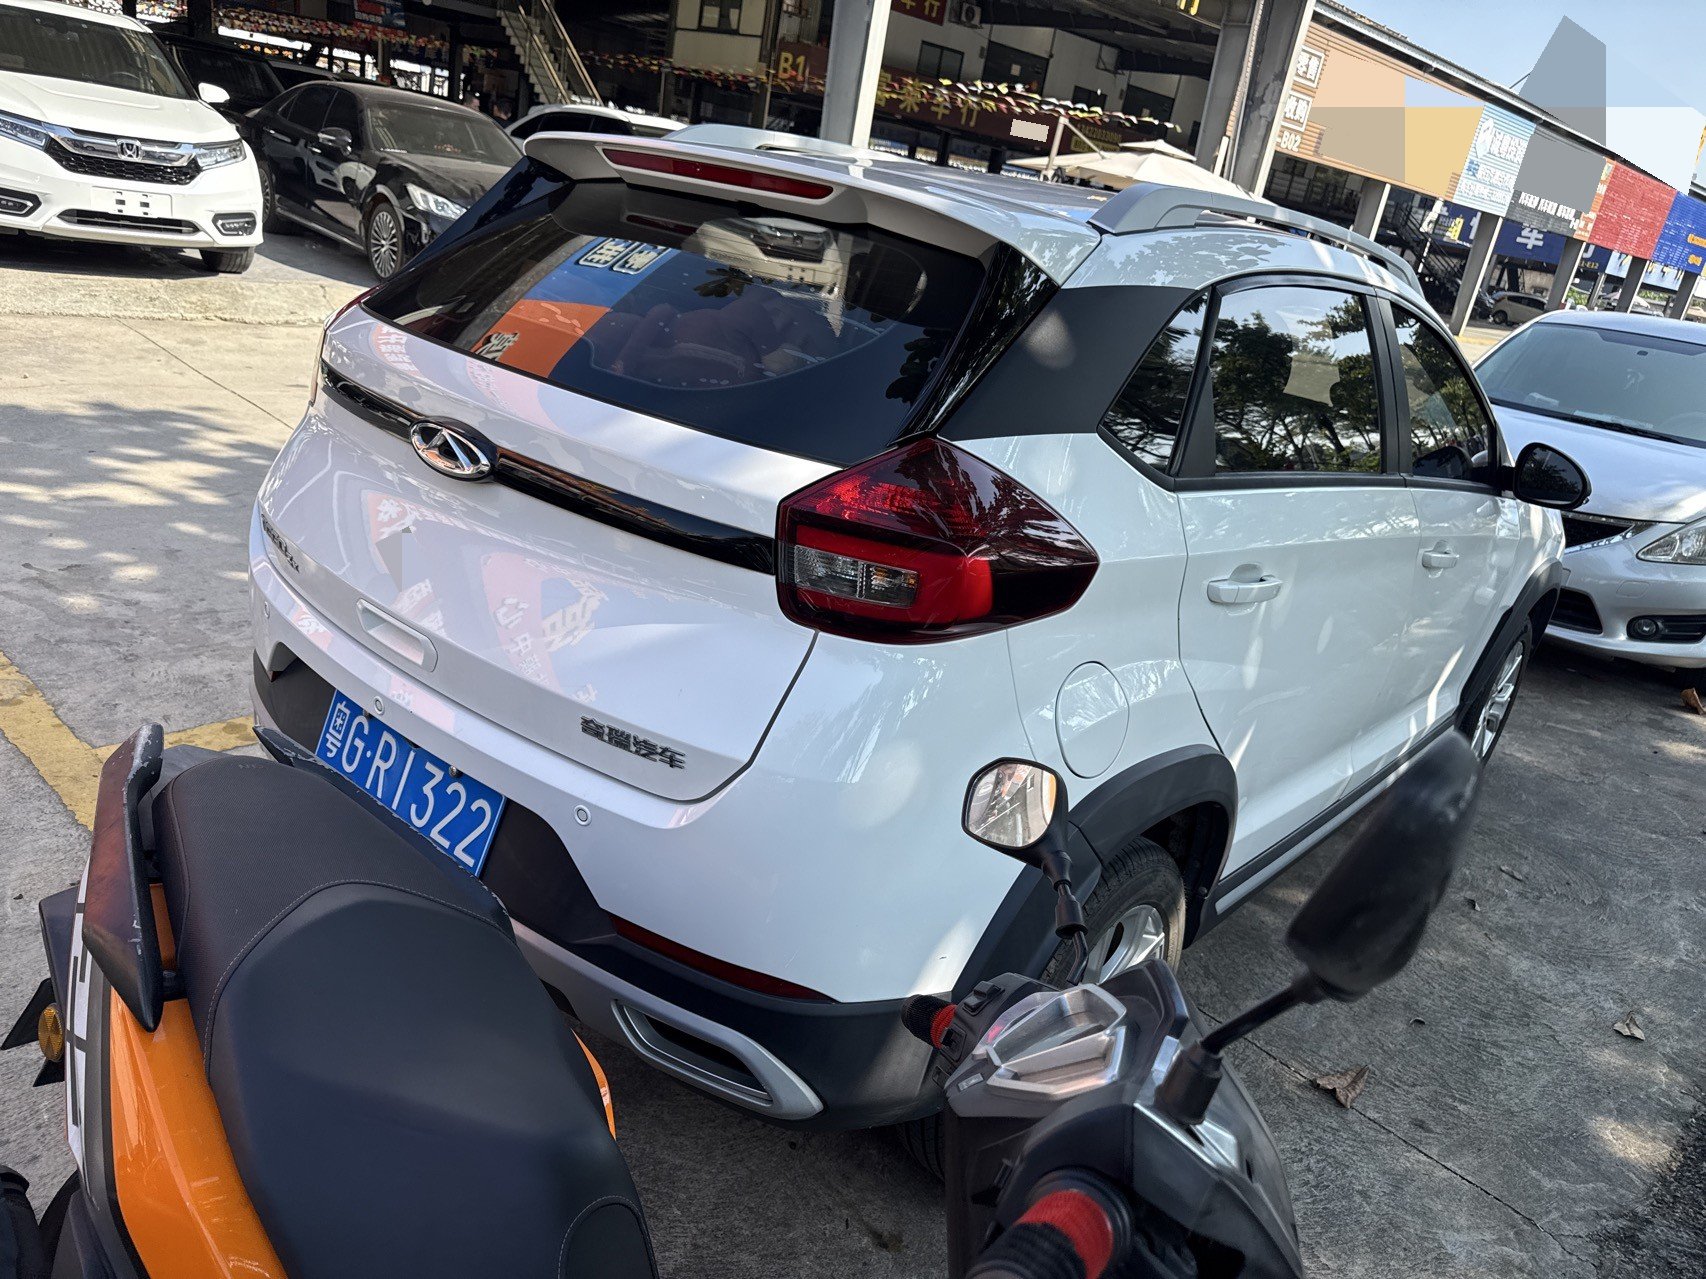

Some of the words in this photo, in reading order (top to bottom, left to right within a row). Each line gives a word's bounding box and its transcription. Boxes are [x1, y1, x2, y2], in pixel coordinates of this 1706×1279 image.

[777, 51, 806, 81] B1
[580, 715, 686, 770] 奇瑞汽车
